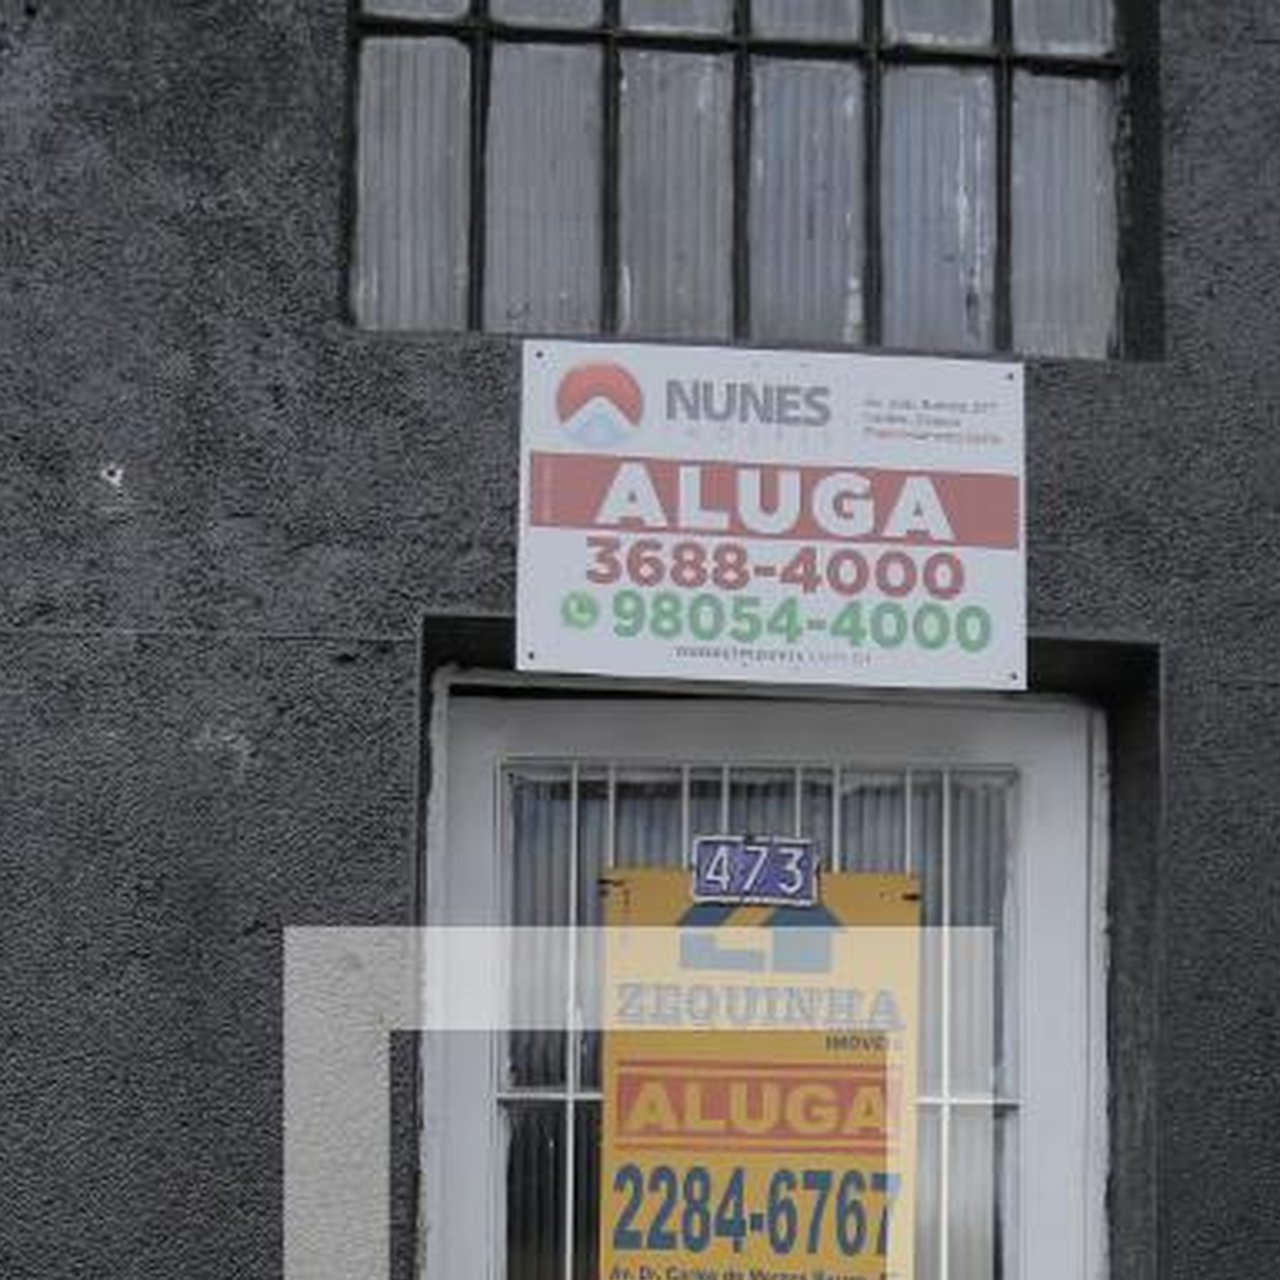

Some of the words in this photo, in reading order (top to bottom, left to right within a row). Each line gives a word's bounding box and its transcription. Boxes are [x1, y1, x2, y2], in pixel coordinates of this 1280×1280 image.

[665, 379, 831, 427] NUNES
[594, 460, 956, 541] ALUGA
[586, 536, 966, 600] 3688-4000
[611, 589, 992, 653] 98054-4000
[704, 845, 805, 893] 473
[617, 982, 906, 1031] ZEQUINHA
[630, 1082, 900, 1134] ALUGA
[612, 1163, 902, 1257] 2284-6767
